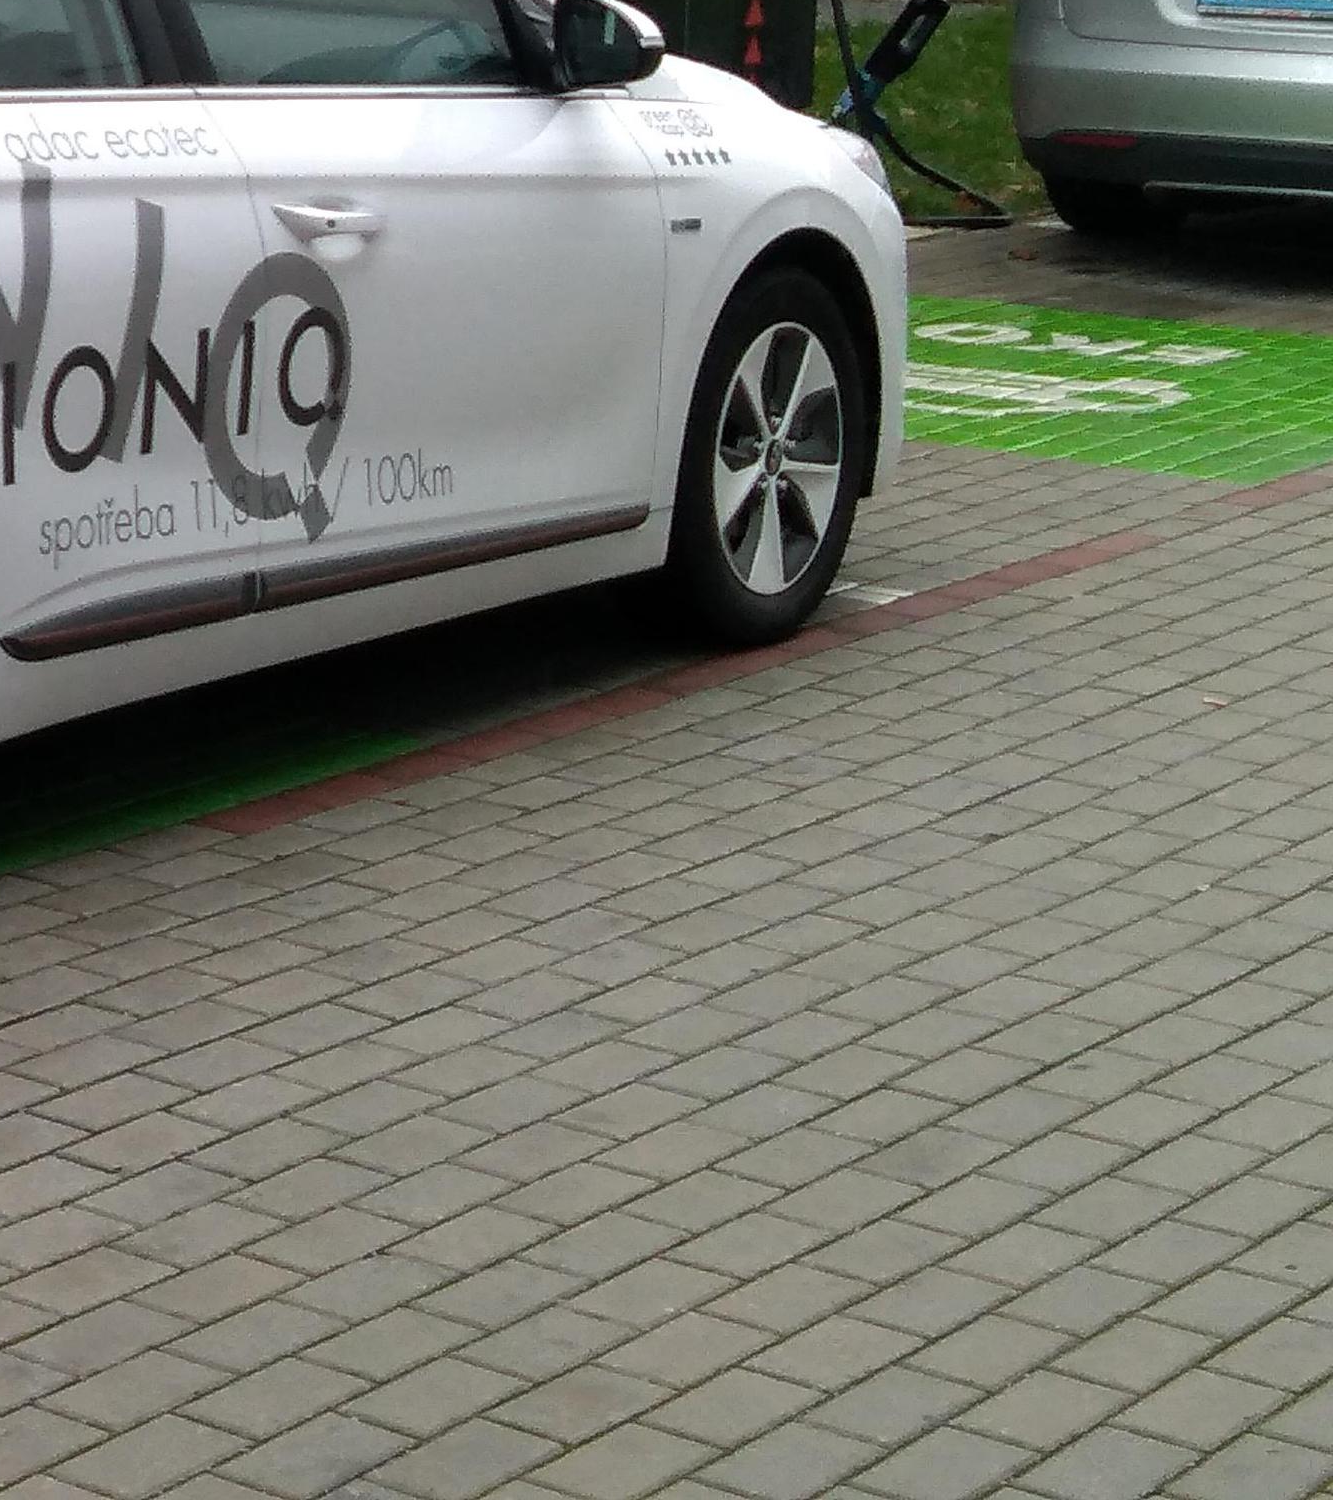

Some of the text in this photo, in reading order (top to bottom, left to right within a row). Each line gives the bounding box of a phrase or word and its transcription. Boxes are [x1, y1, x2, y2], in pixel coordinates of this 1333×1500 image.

[4, 112, 99, 162] adac
[1, 305, 345, 487] IONIQ
[38, 482, 178, 570] spotřeba
[363, 447, 455, 507] 100km
